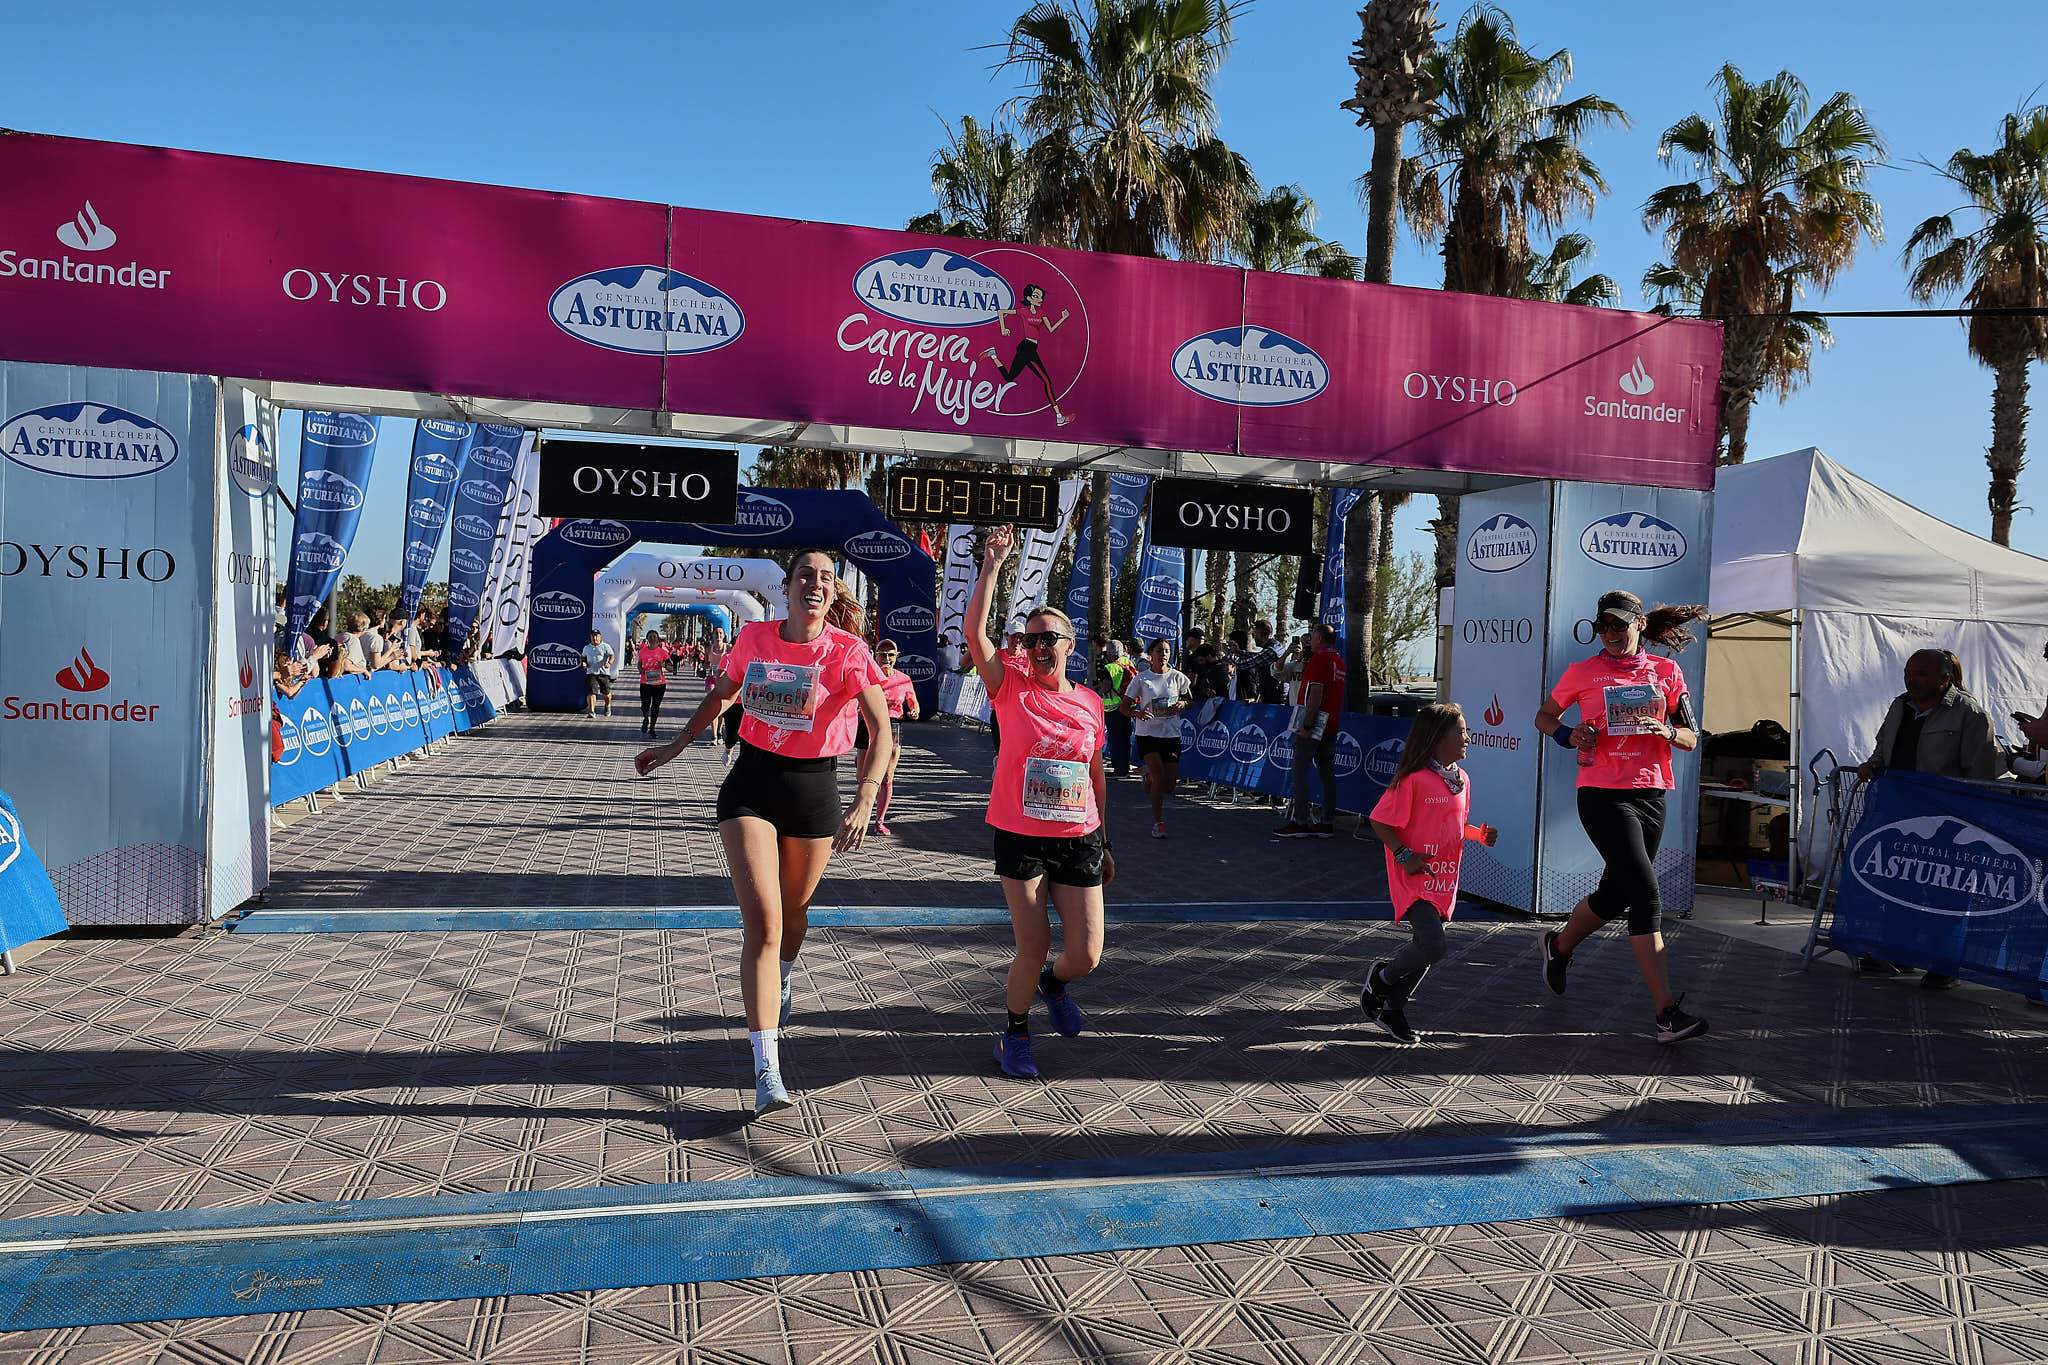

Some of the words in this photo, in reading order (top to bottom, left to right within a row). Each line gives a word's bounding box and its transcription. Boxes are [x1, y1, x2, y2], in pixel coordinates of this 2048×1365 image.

[0, 250, 171, 290] Santander
[891, 271, 943, 285] CENTRAL
[947, 277, 999, 290] LECHERA
[282, 269, 447, 311] OYSHO
[596, 293, 657, 306] CENTRAL
[865, 270, 1001, 312] ASTURIANA
[564, 292, 730, 337] ASTURIANA
[837, 313, 970, 364] Carrera
[1183, 349, 1317, 390] ASTURIANA
[1209, 350, 1259, 362] CENTRAL
[1263, 354, 1313, 367] LECHERA
[868, 358, 893, 386] de
[899, 359, 916, 388] la
[911, 360, 1017, 425] Mujer
[1403, 371, 1518, 407] OYSHO
[1584, 394, 1687, 425] Santander
[9, 426, 166, 463] ASTURIANA
[38, 426, 97, 437] CENTRAL
[102, 430, 160, 441] LECHERA
[572, 465, 711, 501] OYSHO
[899, 476, 1046, 518] 00:37:47
[737, 512, 786, 527] RIANA
[1178, 501, 1291, 534] OYSHO
[565, 526, 626, 542] ASTURIANA
[850, 541, 908, 554] ASTURIANA
[1588, 530, 1679, 558] ASTURIANA
[1604, 530, 1638, 539] CENTRAL
[1640, 531, 1677, 541] LECHERA
[0, 541, 176, 583] OYSHO
[1150, 545, 1185, 560] ASTURIA
[1470, 538, 1532, 560] ASTURIANA
[227, 551, 271, 588] OYSHO
[657, 561, 745, 582] OYSHO
[767, 584, 783, 592] OYS
[533, 601, 582, 615] ASTURIANA
[889, 615, 933, 626] ASTURIANA
[1463, 617, 1533, 645] OYSHO
[530, 652, 579, 667] ASTURIANA
[2, 695, 160, 722] Santander
[1271, 740, 1295, 760] ASTURI
[1334, 752, 1358, 768] RIANA
[1367, 752, 1398, 775] ASTURI
[1424, 844, 1439, 857] TU
[1894, 841, 1950, 859] CENTRAL
[1956, 851, 2018, 871] LECHERA
[1859, 840, 2017, 902] ASTURIANA
